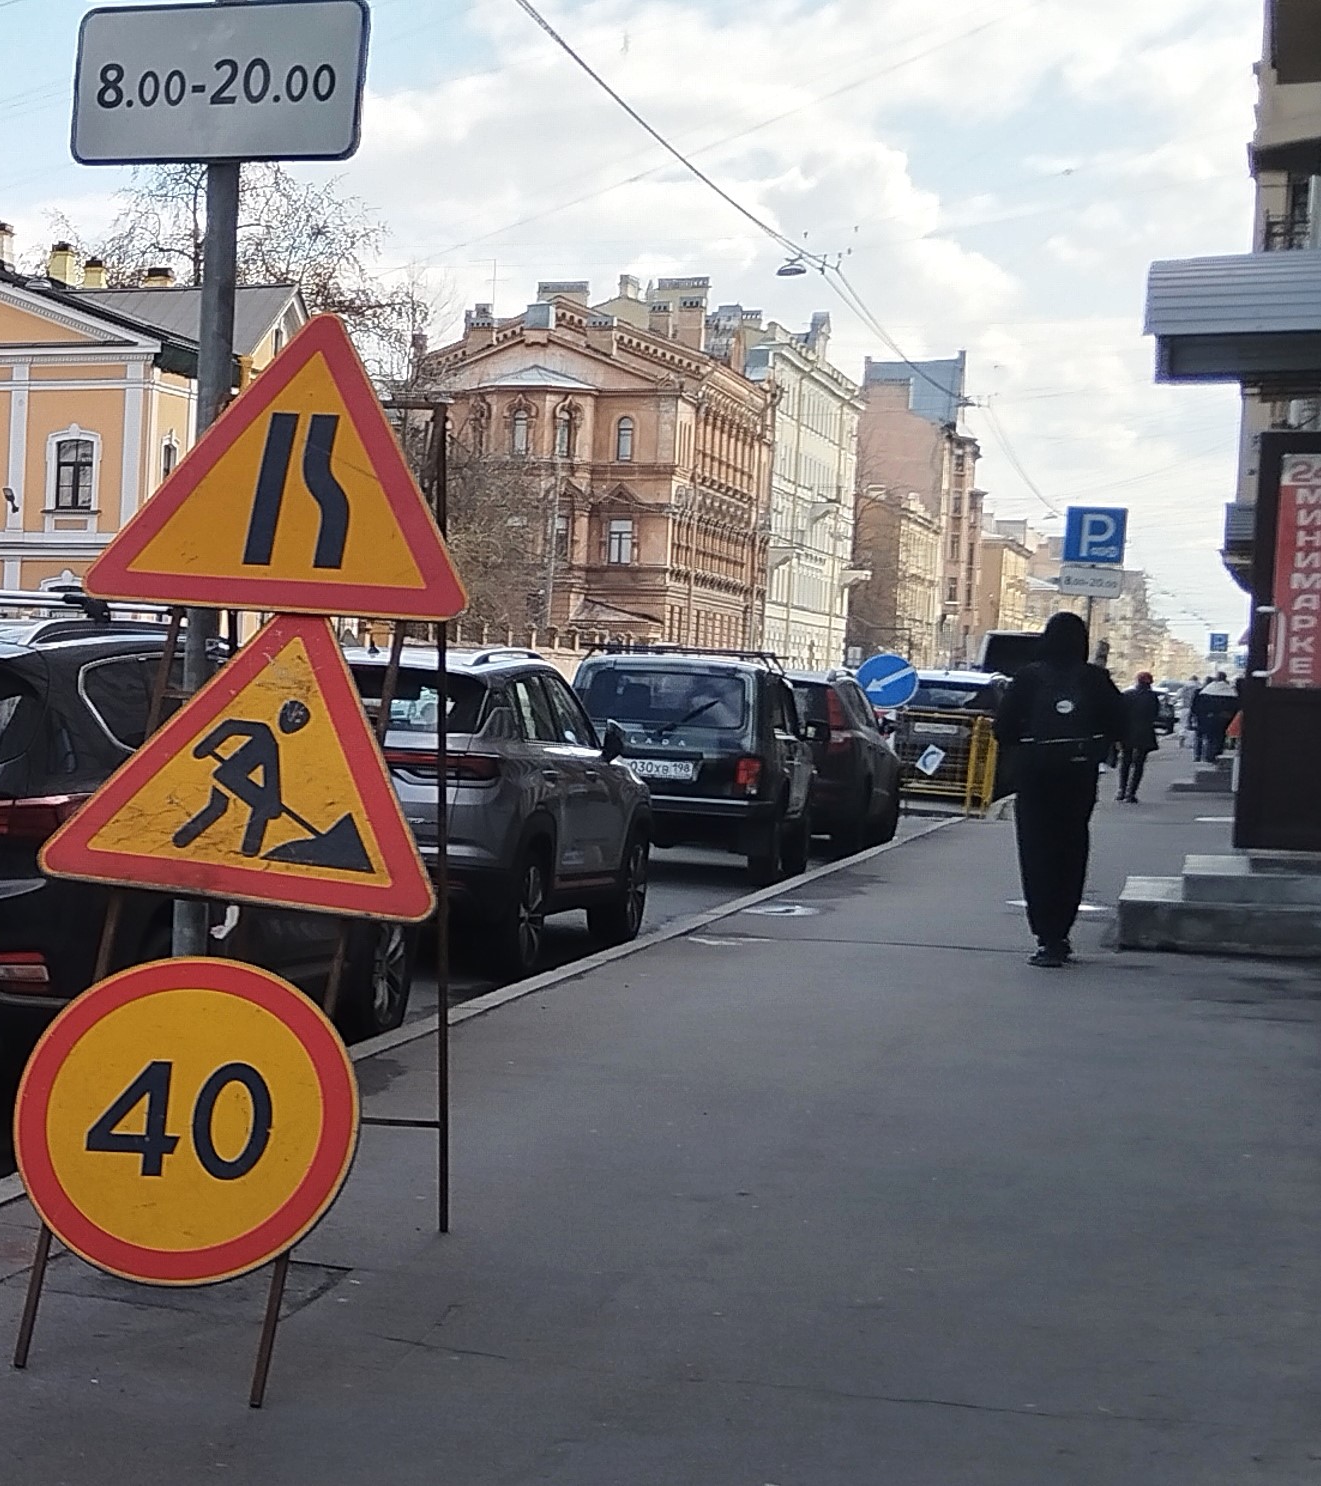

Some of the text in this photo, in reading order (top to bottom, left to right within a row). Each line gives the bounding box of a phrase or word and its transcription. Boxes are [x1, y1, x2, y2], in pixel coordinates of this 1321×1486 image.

[96, 57, 336, 109] 8.00-20.00
[630, 736, 685, 746] LADA
[85, 1060, 273, 1181] 40
